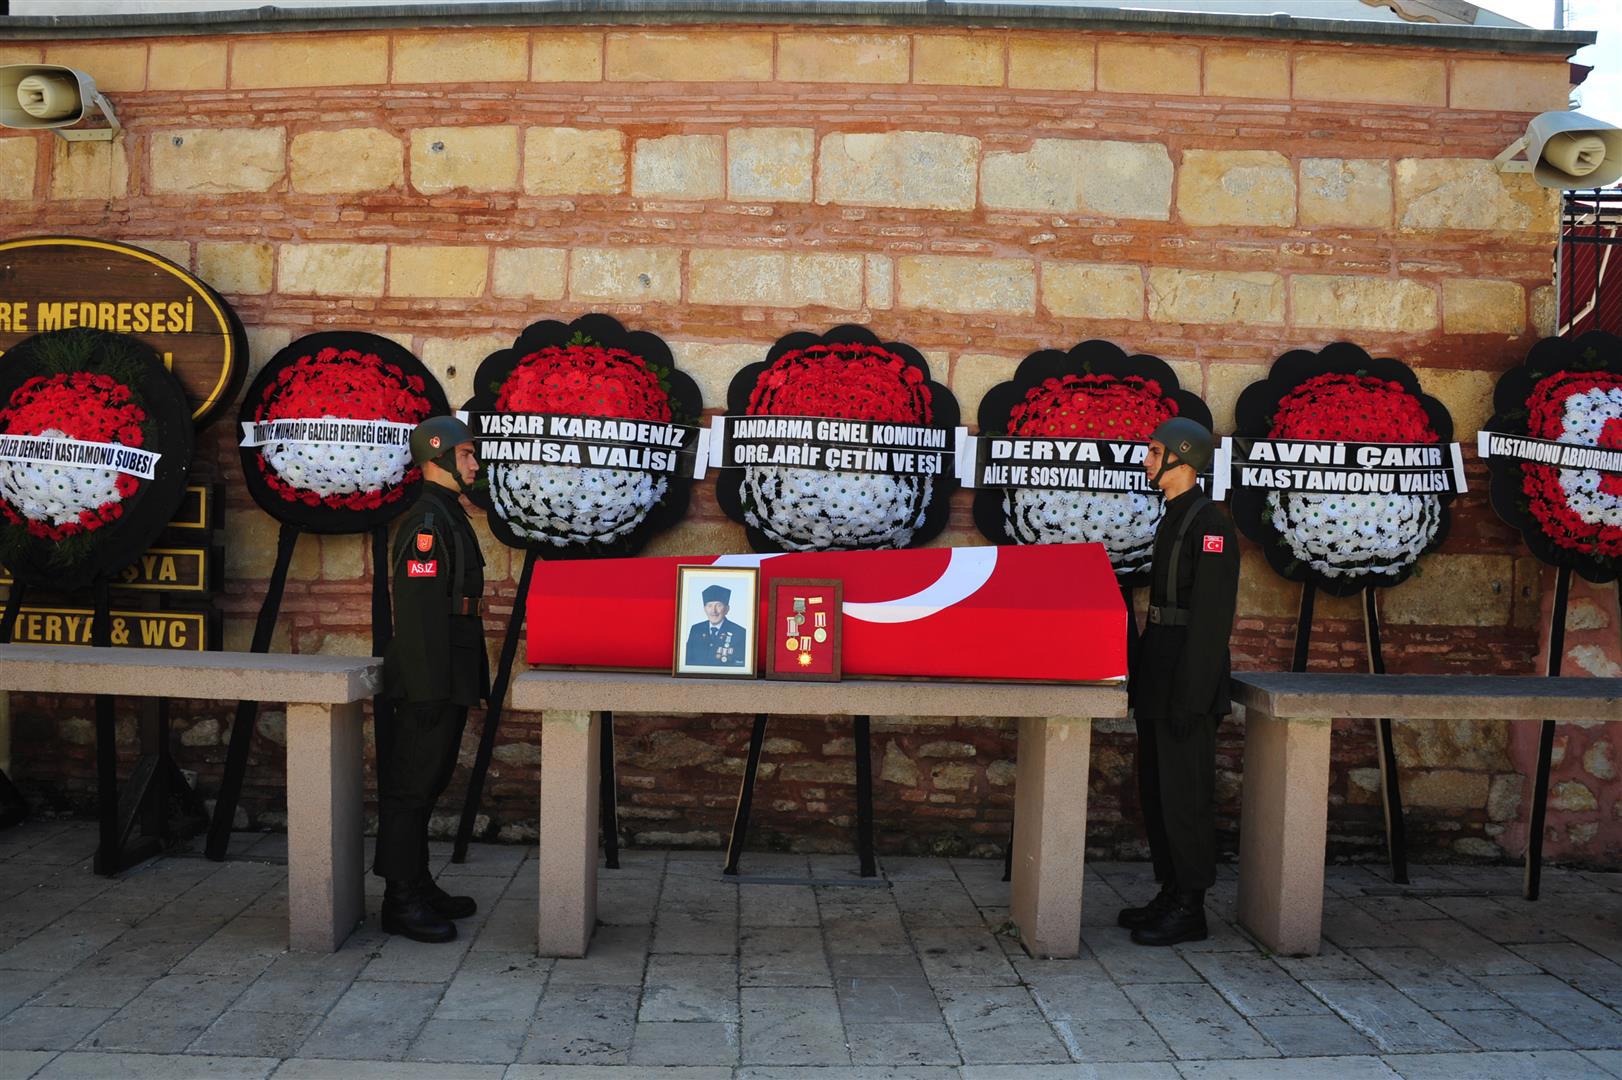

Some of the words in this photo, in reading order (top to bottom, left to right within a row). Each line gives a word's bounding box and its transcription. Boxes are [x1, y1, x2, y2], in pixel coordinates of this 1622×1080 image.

[0, 302, 29, 332] RE
[37, 296, 194, 333] MEDRESESİ
[274, 419, 307, 440] MUHARİP
[308, 420, 338, 441] GAZİLER
[340, 422, 375, 444] DERNEĞİ
[377, 426, 400, 445] GENEL
[479, 414, 544, 437] YAŞAR
[550, 416, 685, 448] KARADENİZ
[732, 419, 813, 440] JANDARMA
[817, 421, 868, 443] GENEL
[872, 424, 946, 448] KOMUTANI
[18, 438, 54, 460] DERNEĞİ
[54, 442, 115, 466] KASTAMONU
[115, 449, 153, 475] ŞUBESİ
[481, 439, 581, 464] MANİSA
[588, 446, 677, 472] VALİSİ
[734, 443, 821, 466] ORG.ARİF
[825, 447, 888, 472] ÇETİN
[892, 452, 914, 473] VE
[917, 453, 942, 477] EŞİ
[991, 440, 1101, 462] DERYA
[1249, 441, 1346, 465] AVNİ
[1356, 446, 1442, 469] ÇAKIR
[1490, 436, 1562, 464] KASTAMONU
[983, 462, 1010, 485] AİLE
[1011, 465, 1028, 485] VE
[1031, 466, 1085, 488] SOSYAL
[1241, 467, 1395, 492] KASTAMONU
[1399, 470, 1449, 493] VALİSİ
[110, 618, 130, 645] &
[140, 619, 187, 648] WC
